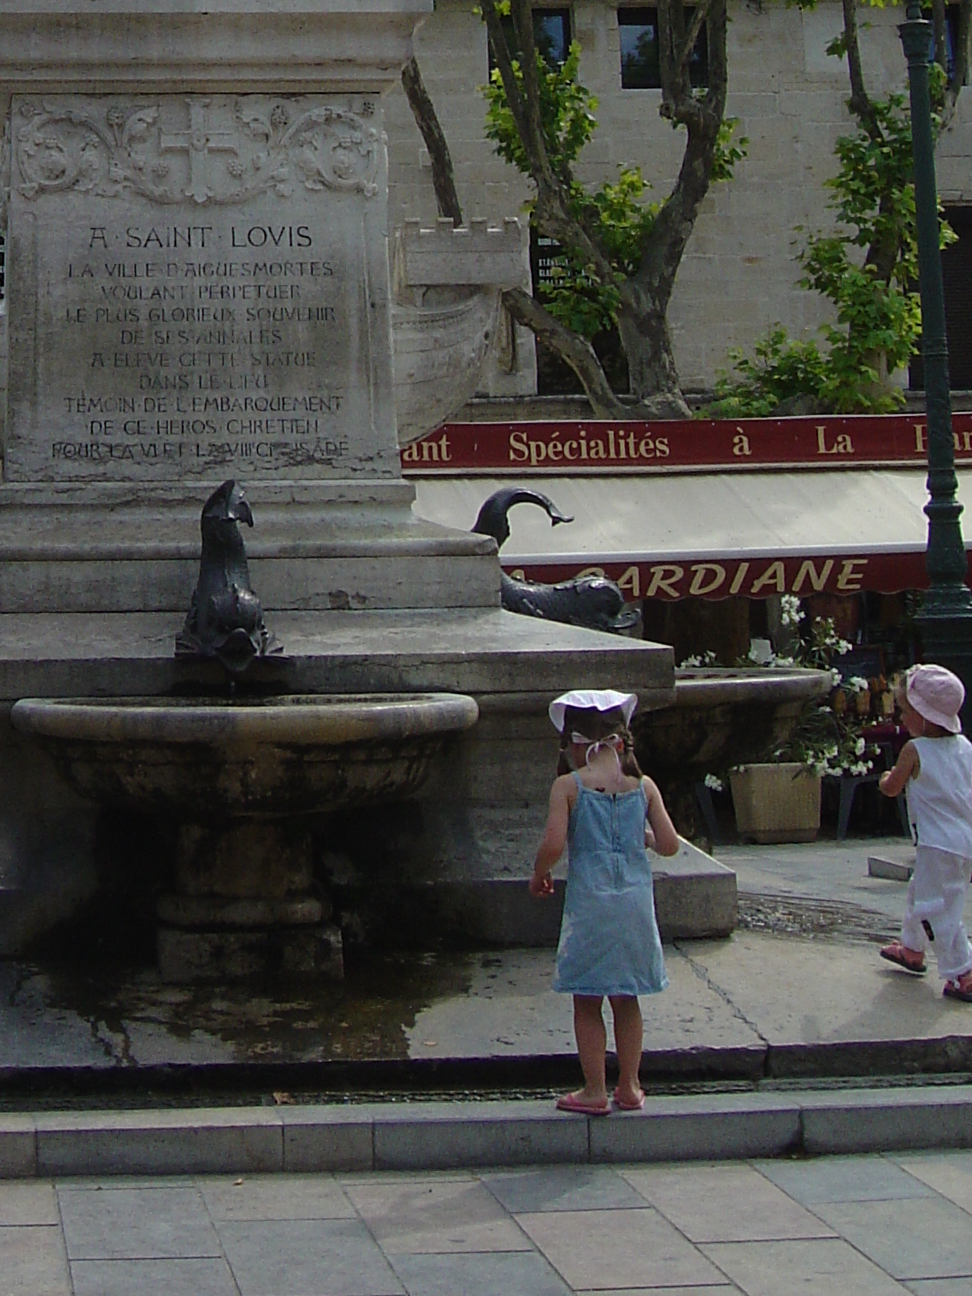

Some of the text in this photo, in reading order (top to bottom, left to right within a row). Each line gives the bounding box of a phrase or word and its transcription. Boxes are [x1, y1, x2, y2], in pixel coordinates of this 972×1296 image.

[126, 226, 213, 248] SAINT
[231, 226, 313, 248] LOVIS
[68, 263, 94, 278] LA
[104, 262, 158, 278] VILLE
[101, 284, 189, 300] VOULANT
[66, 306, 336, 323] LE PLUS GLORIEUX SOUVENIR
[121, 330, 144, 345] DE
[250, 352, 317, 368] STATUE
[139, 374, 190, 390] DANS
[199, 374, 221, 390] LE
[143, 396, 168, 413] DE
[90, 419, 114, 436] DE
[123, 419, 148, 436] CE
[156, 418, 217, 435] HEROS
[509, 430, 670, 466] Spécialités
[732, 426, 752, 456] à
[815, 425, 855, 454] La
